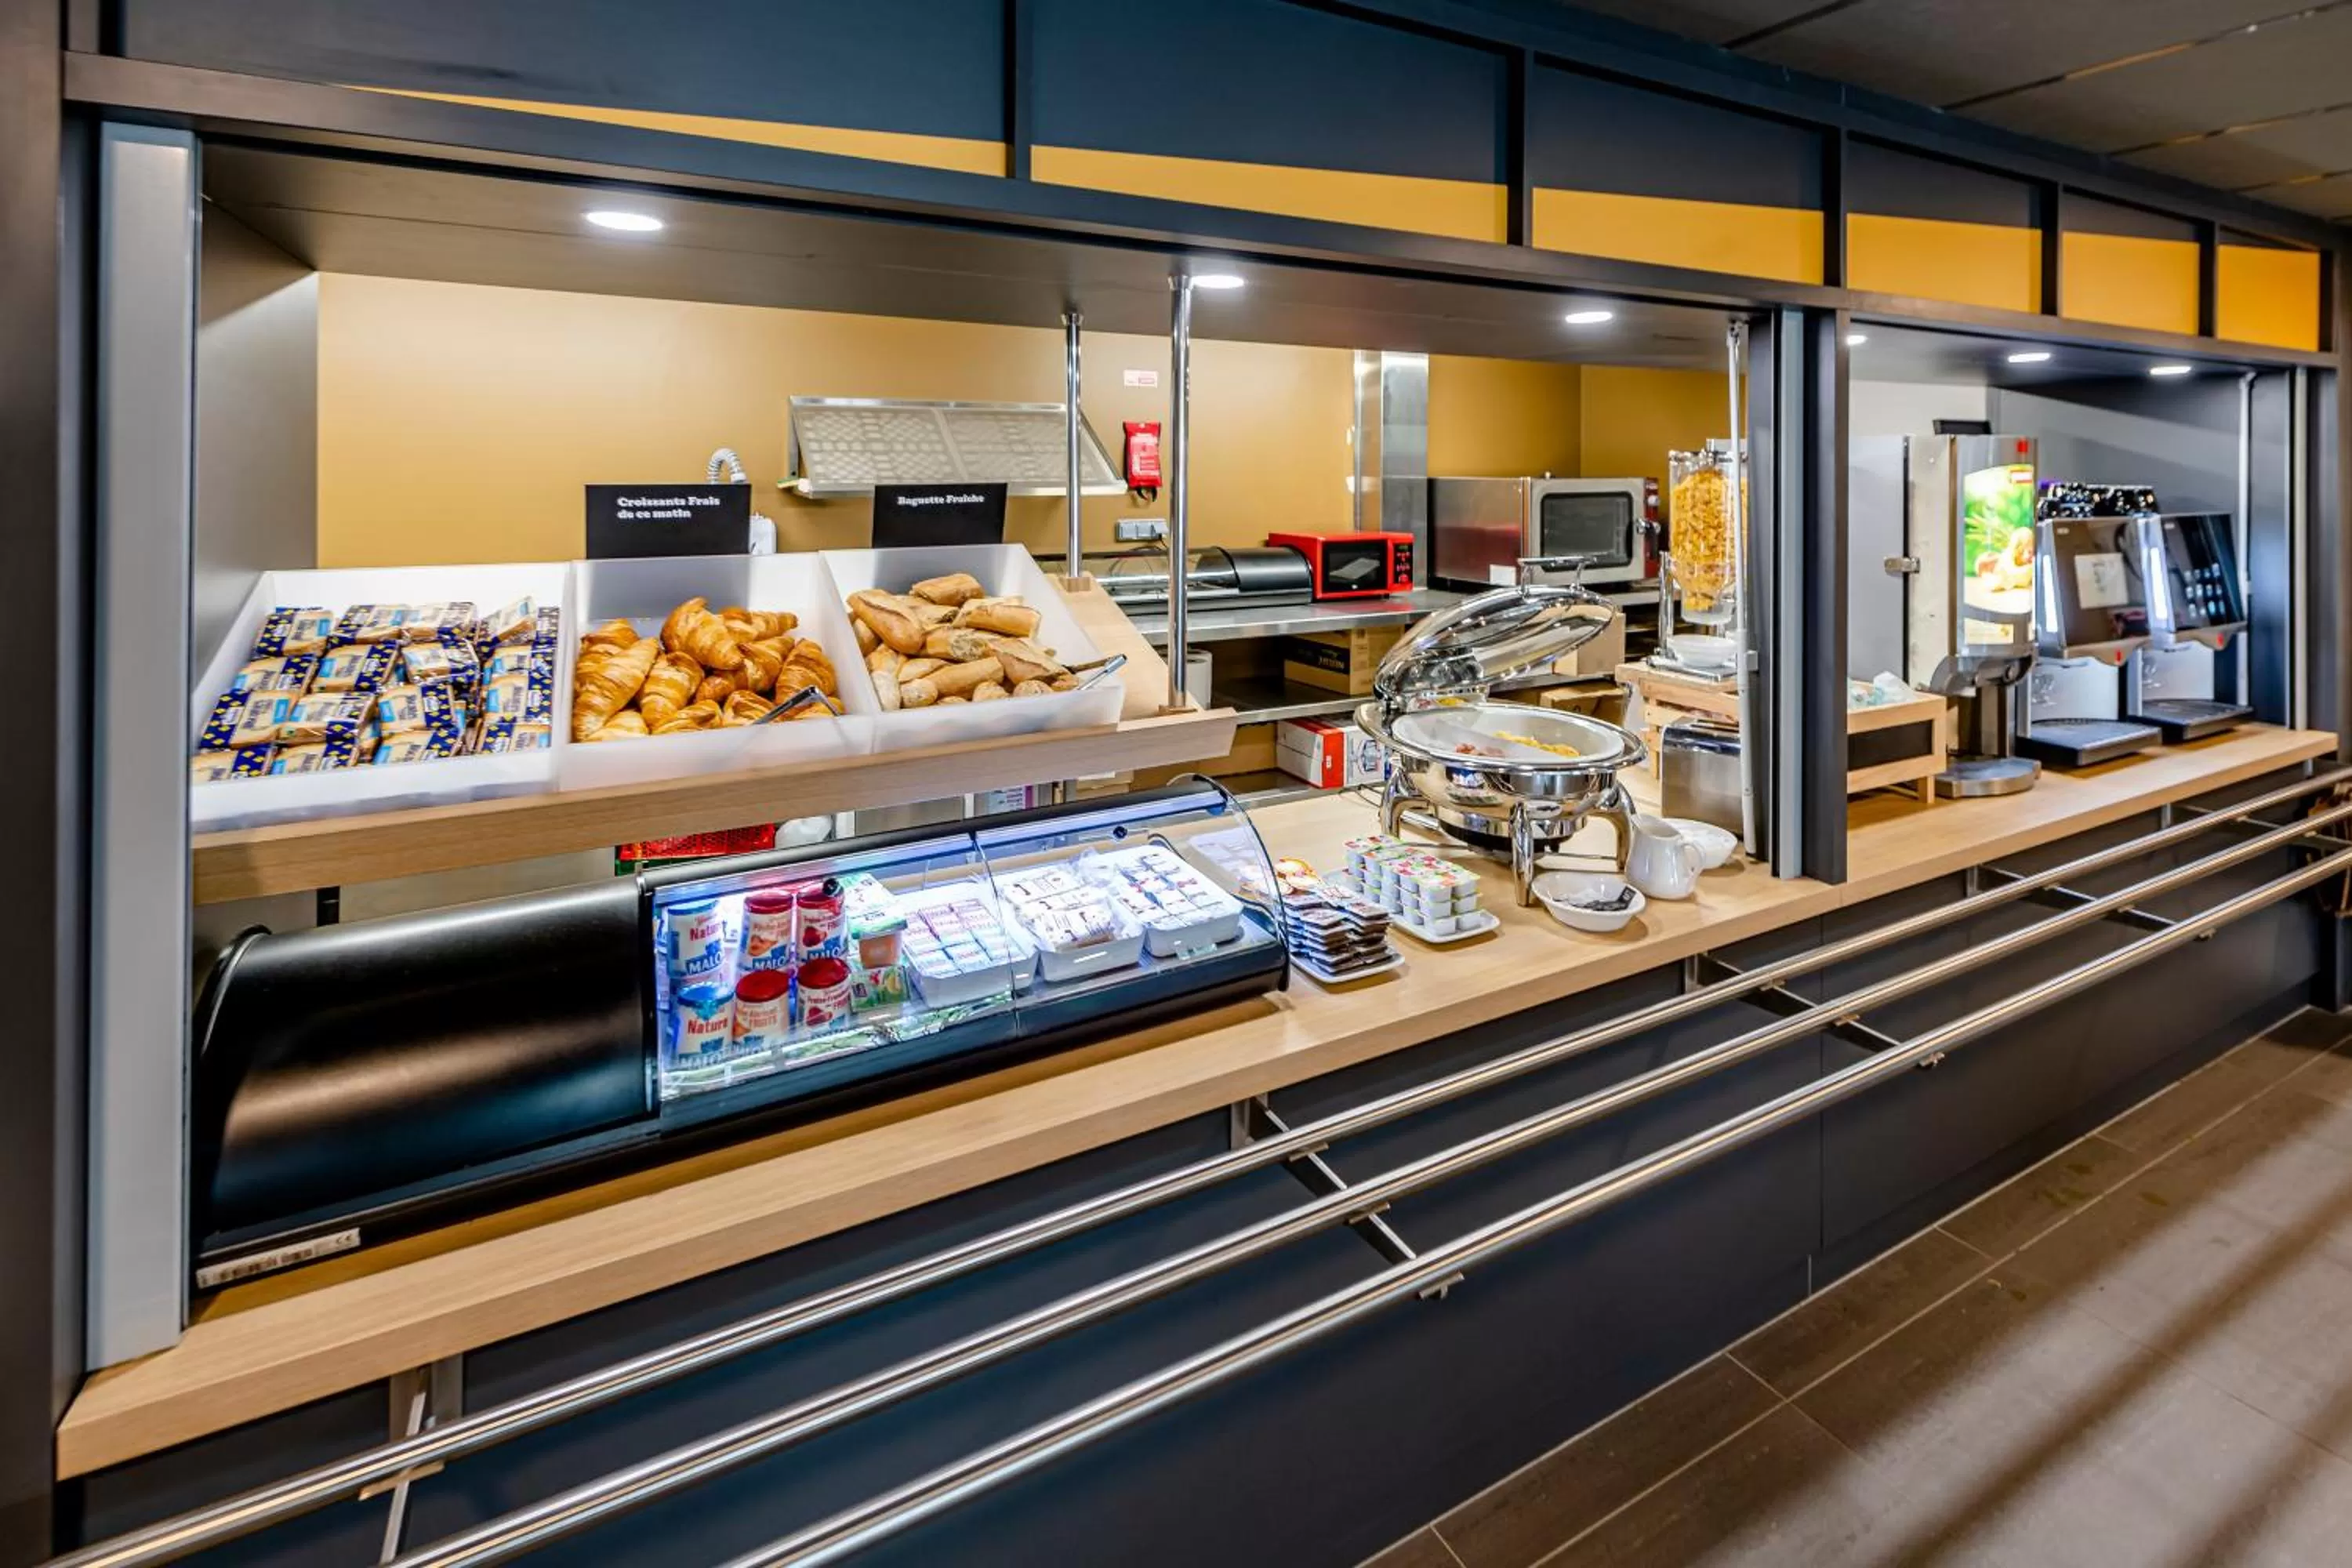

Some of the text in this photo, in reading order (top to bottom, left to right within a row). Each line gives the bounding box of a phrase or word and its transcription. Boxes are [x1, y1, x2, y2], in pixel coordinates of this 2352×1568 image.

[617, 495, 720, 506] Croissants Frais
[897, 496, 944, 507] Baguette
[617, 509, 634, 518] de
[652, 509, 691, 518] matin
[688, 1018, 728, 1035] Nature
